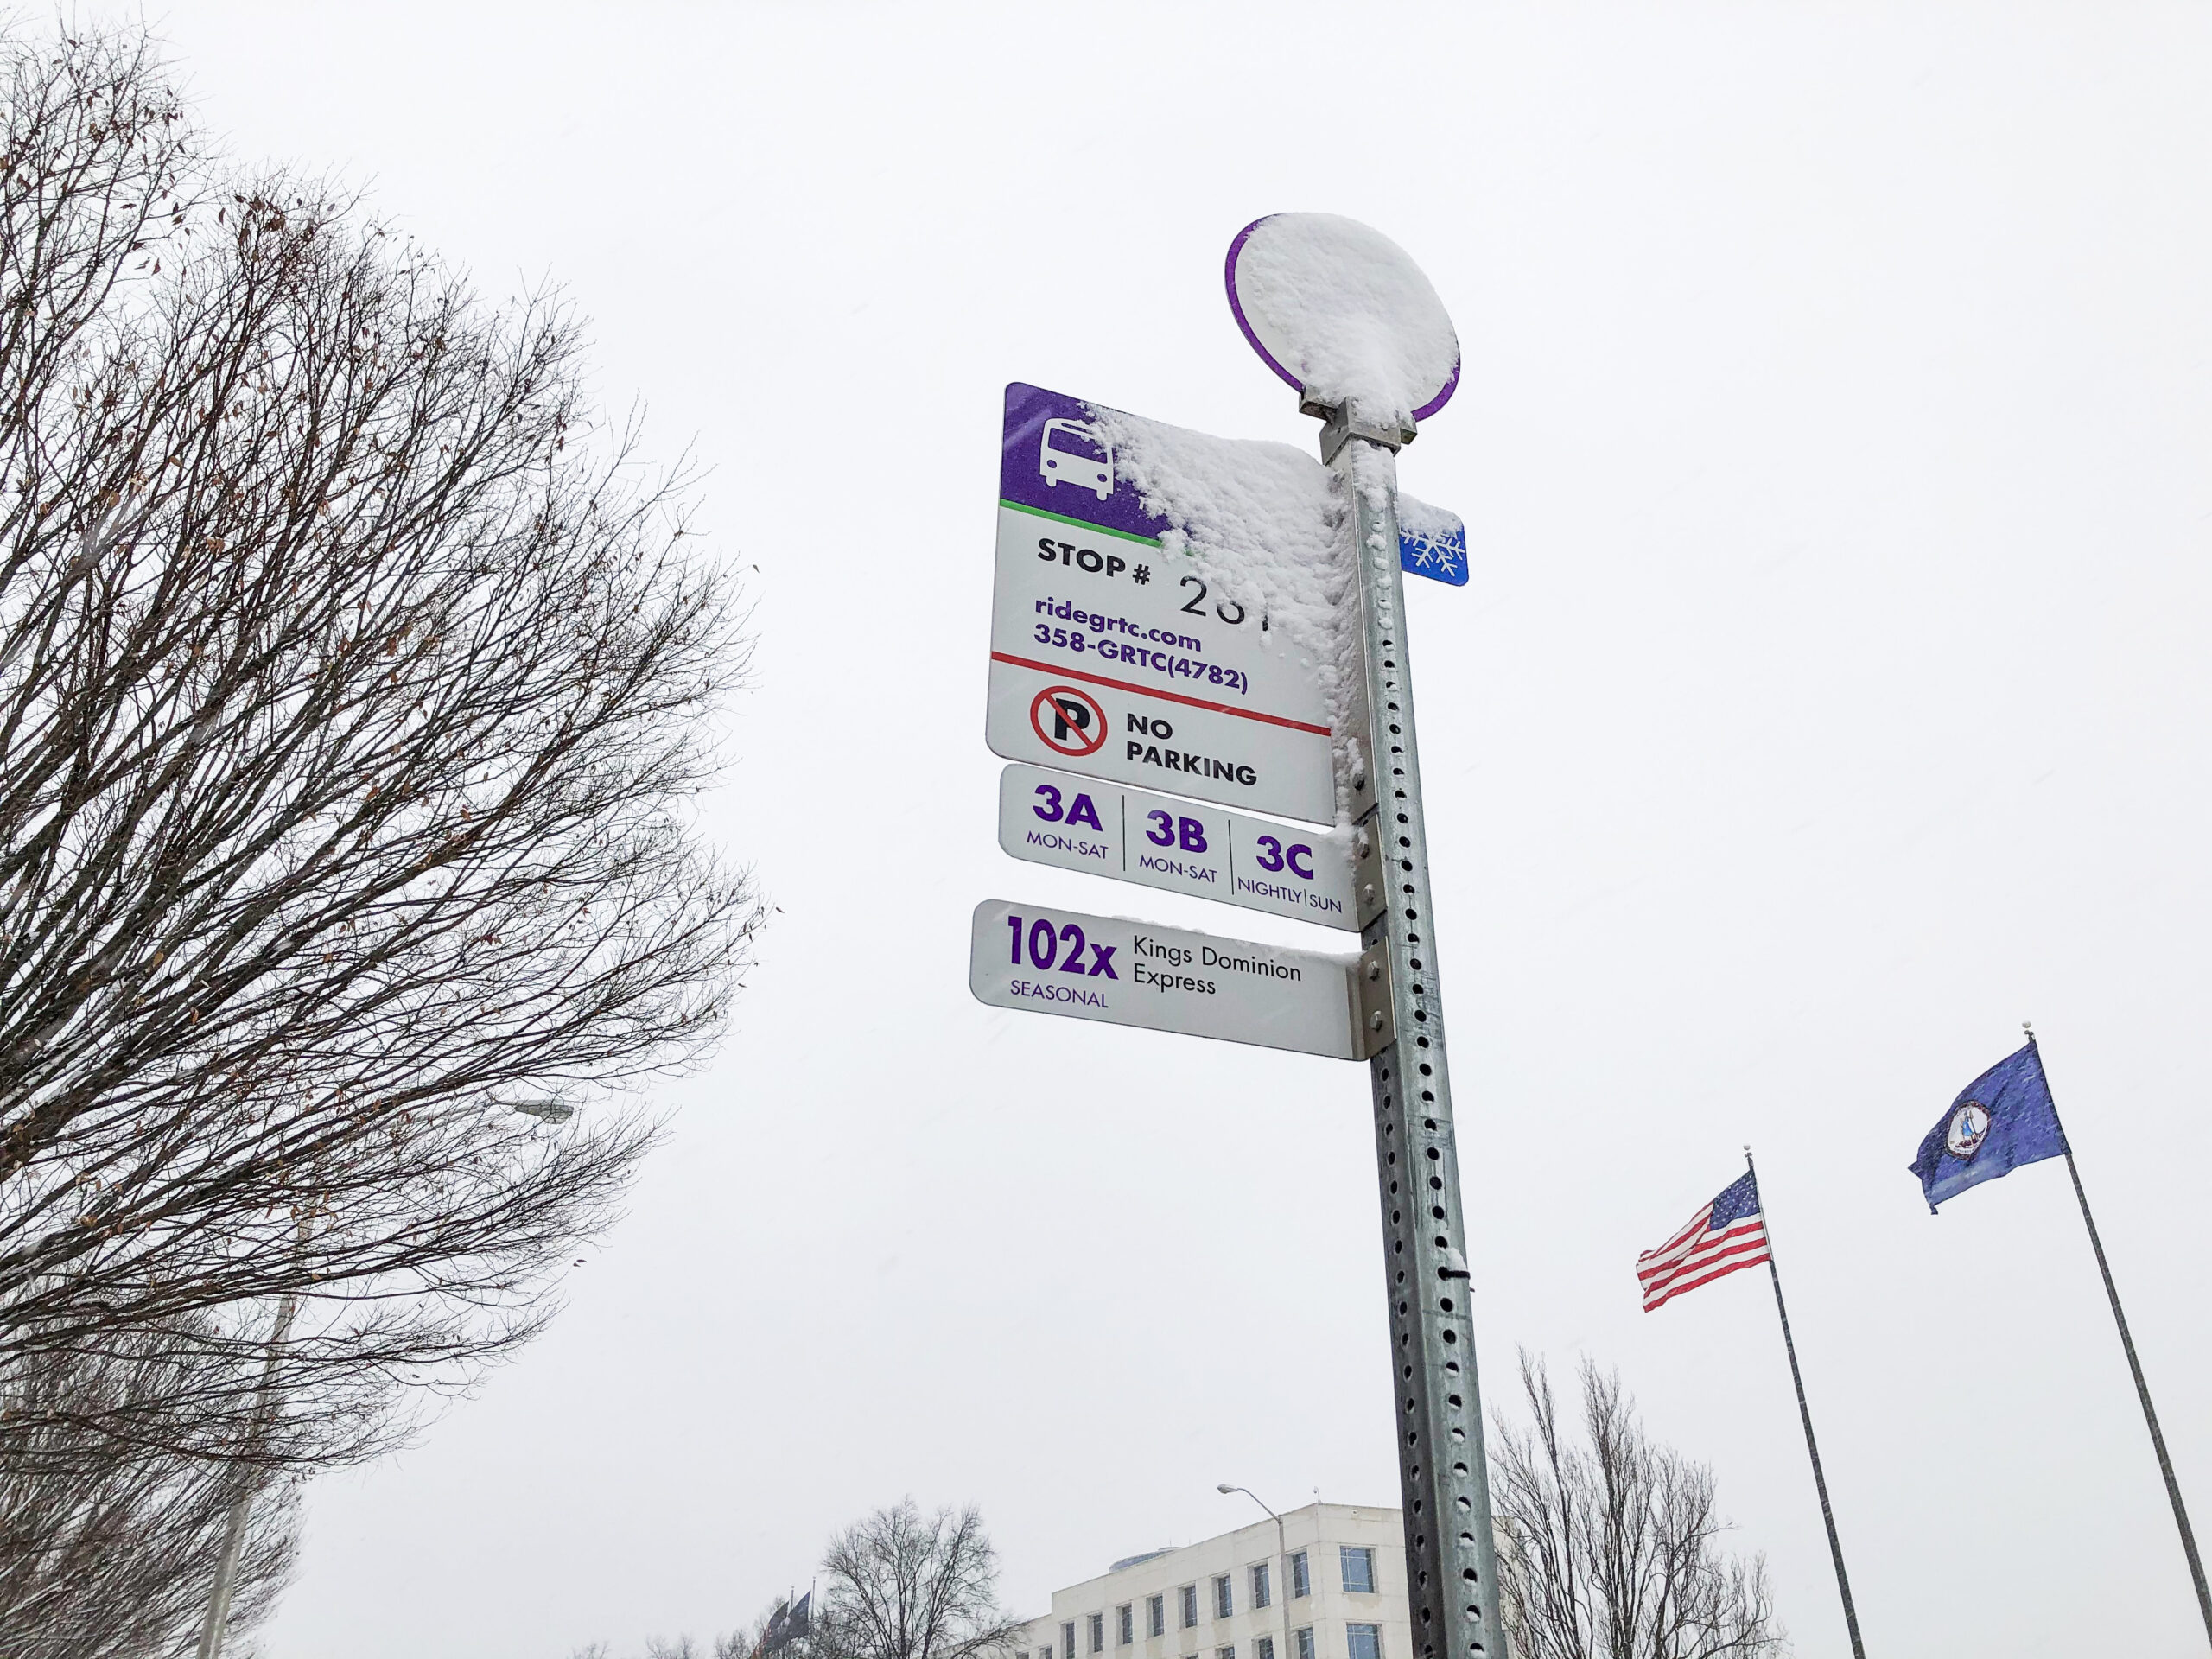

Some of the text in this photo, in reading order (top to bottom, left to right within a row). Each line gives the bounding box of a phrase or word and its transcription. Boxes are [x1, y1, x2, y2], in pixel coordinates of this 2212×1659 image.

[1038, 538, 1126, 577] STOP
[1036, 597, 1202, 652] ridegrtc.com
[1034, 624, 1249, 695] 358-GRTC(4782)
[1128, 713, 1173, 740] NO
[1127, 741, 1257, 786] PARKING
[1033, 785, 1103, 832] 3A
[1027, 830, 1109, 860] MON-SAT
[1146, 810, 1208, 854] 3B
[1140, 855, 1217, 884] MON-SAT
[1256, 836, 1314, 880] 3C
[1007, 915, 1119, 980] 102x
[1134, 935, 1302, 982] Kings Dominion
[1010, 980, 1109, 1008] SEASONAL
[1134, 963, 1217, 997] Express
